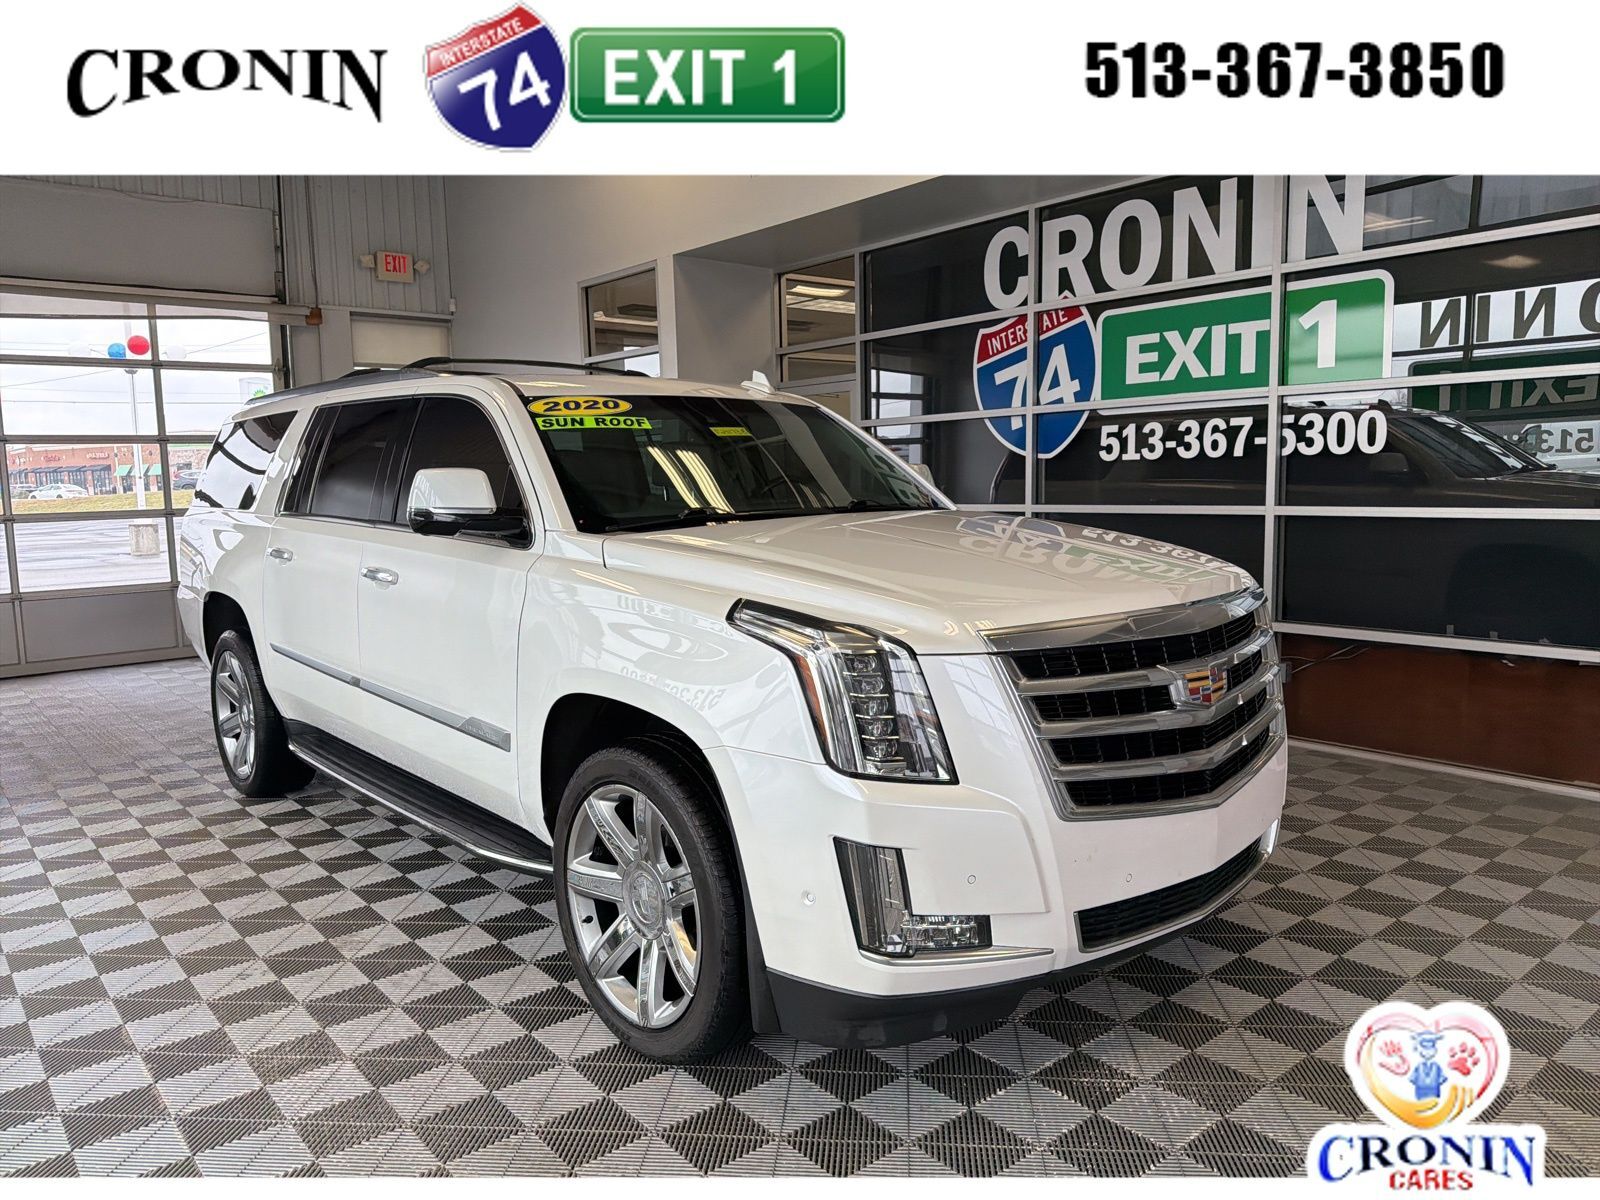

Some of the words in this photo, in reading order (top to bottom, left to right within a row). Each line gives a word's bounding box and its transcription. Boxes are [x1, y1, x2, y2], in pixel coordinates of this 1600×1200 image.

[384, 253, 408, 273] EXIT
[983, 174, 1365, 311] CRONIN
[987, 305, 1069, 356] INTERATE
[1125, 318, 1271, 385] EXIT
[1298, 299, 1338, 369] 1
[542, 400, 620, 412] 2020
[993, 343, 1081, 431] 74
[541, 417, 585, 429] SUN
[593, 417, 646, 428] ROOF
[1099, 409, 1388, 462] 513-367-5300
